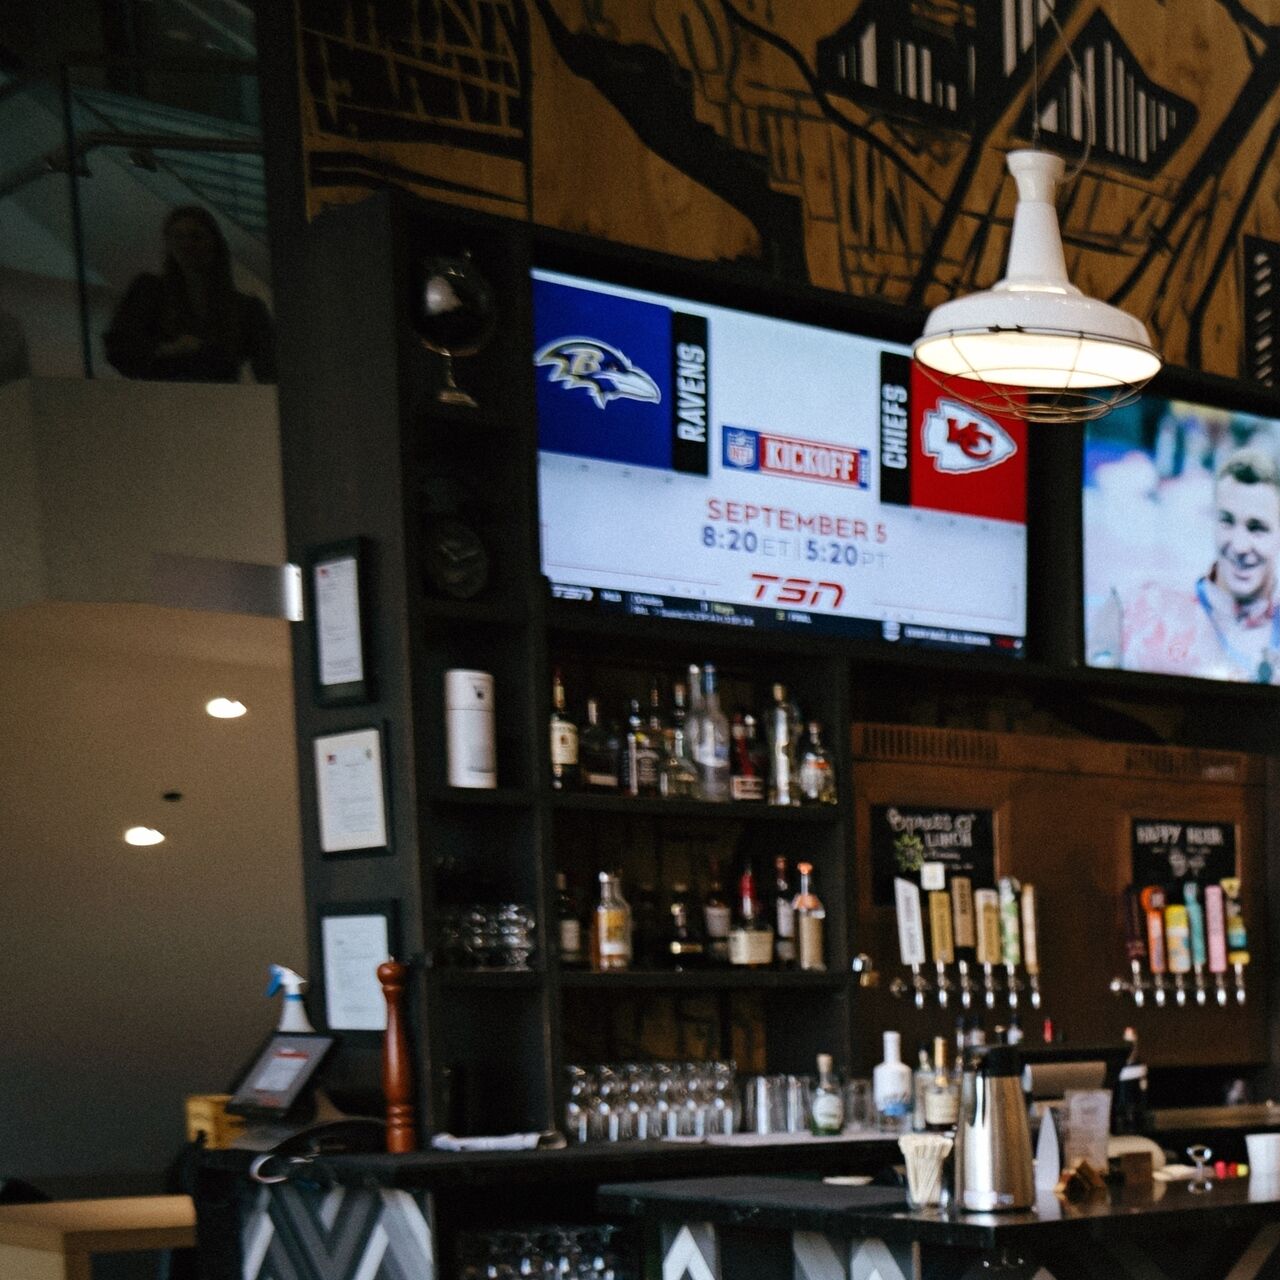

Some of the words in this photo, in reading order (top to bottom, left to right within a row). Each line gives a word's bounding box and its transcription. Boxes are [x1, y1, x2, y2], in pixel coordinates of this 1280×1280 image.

[676, 342, 706, 442] RAVENS
[881, 383, 908, 469] CHIEFS
[765, 439, 854, 480] KICKOFF
[707, 499, 869, 542] SEPTEMBER
[876, 523, 887, 544] 5
[751, 572, 845, 609] TSN
